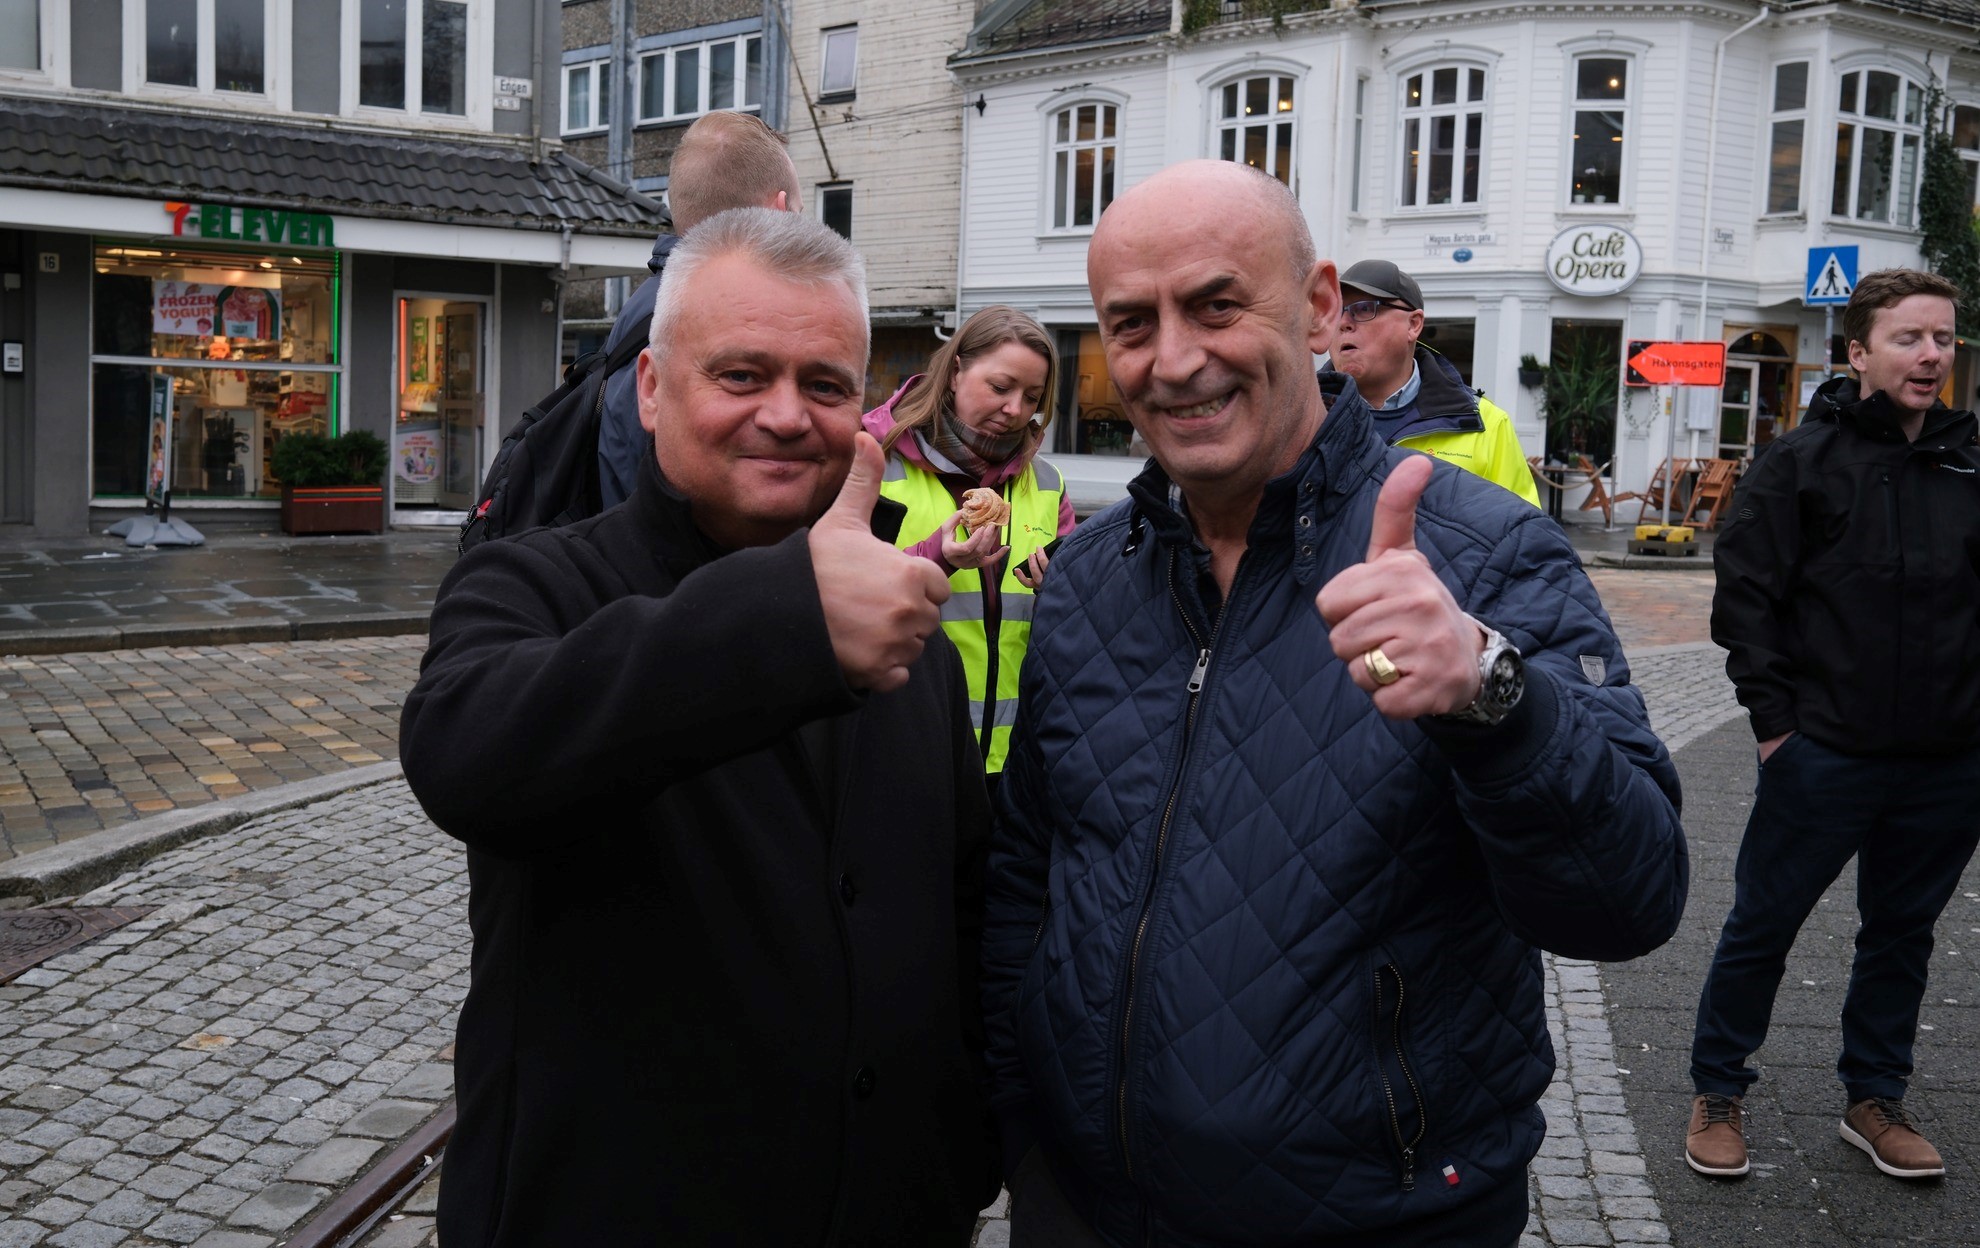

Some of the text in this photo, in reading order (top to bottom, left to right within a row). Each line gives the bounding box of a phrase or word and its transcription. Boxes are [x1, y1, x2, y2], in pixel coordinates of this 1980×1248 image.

[500, 79, 527, 95] Engen
[1573, 232, 1625, 257] Café
[44, 256, 56, 269] 16
[1555, 255, 1626, 285] Opera
[159, 294, 217, 307] FROZEN
[159, 306, 218, 319] YOGURT
